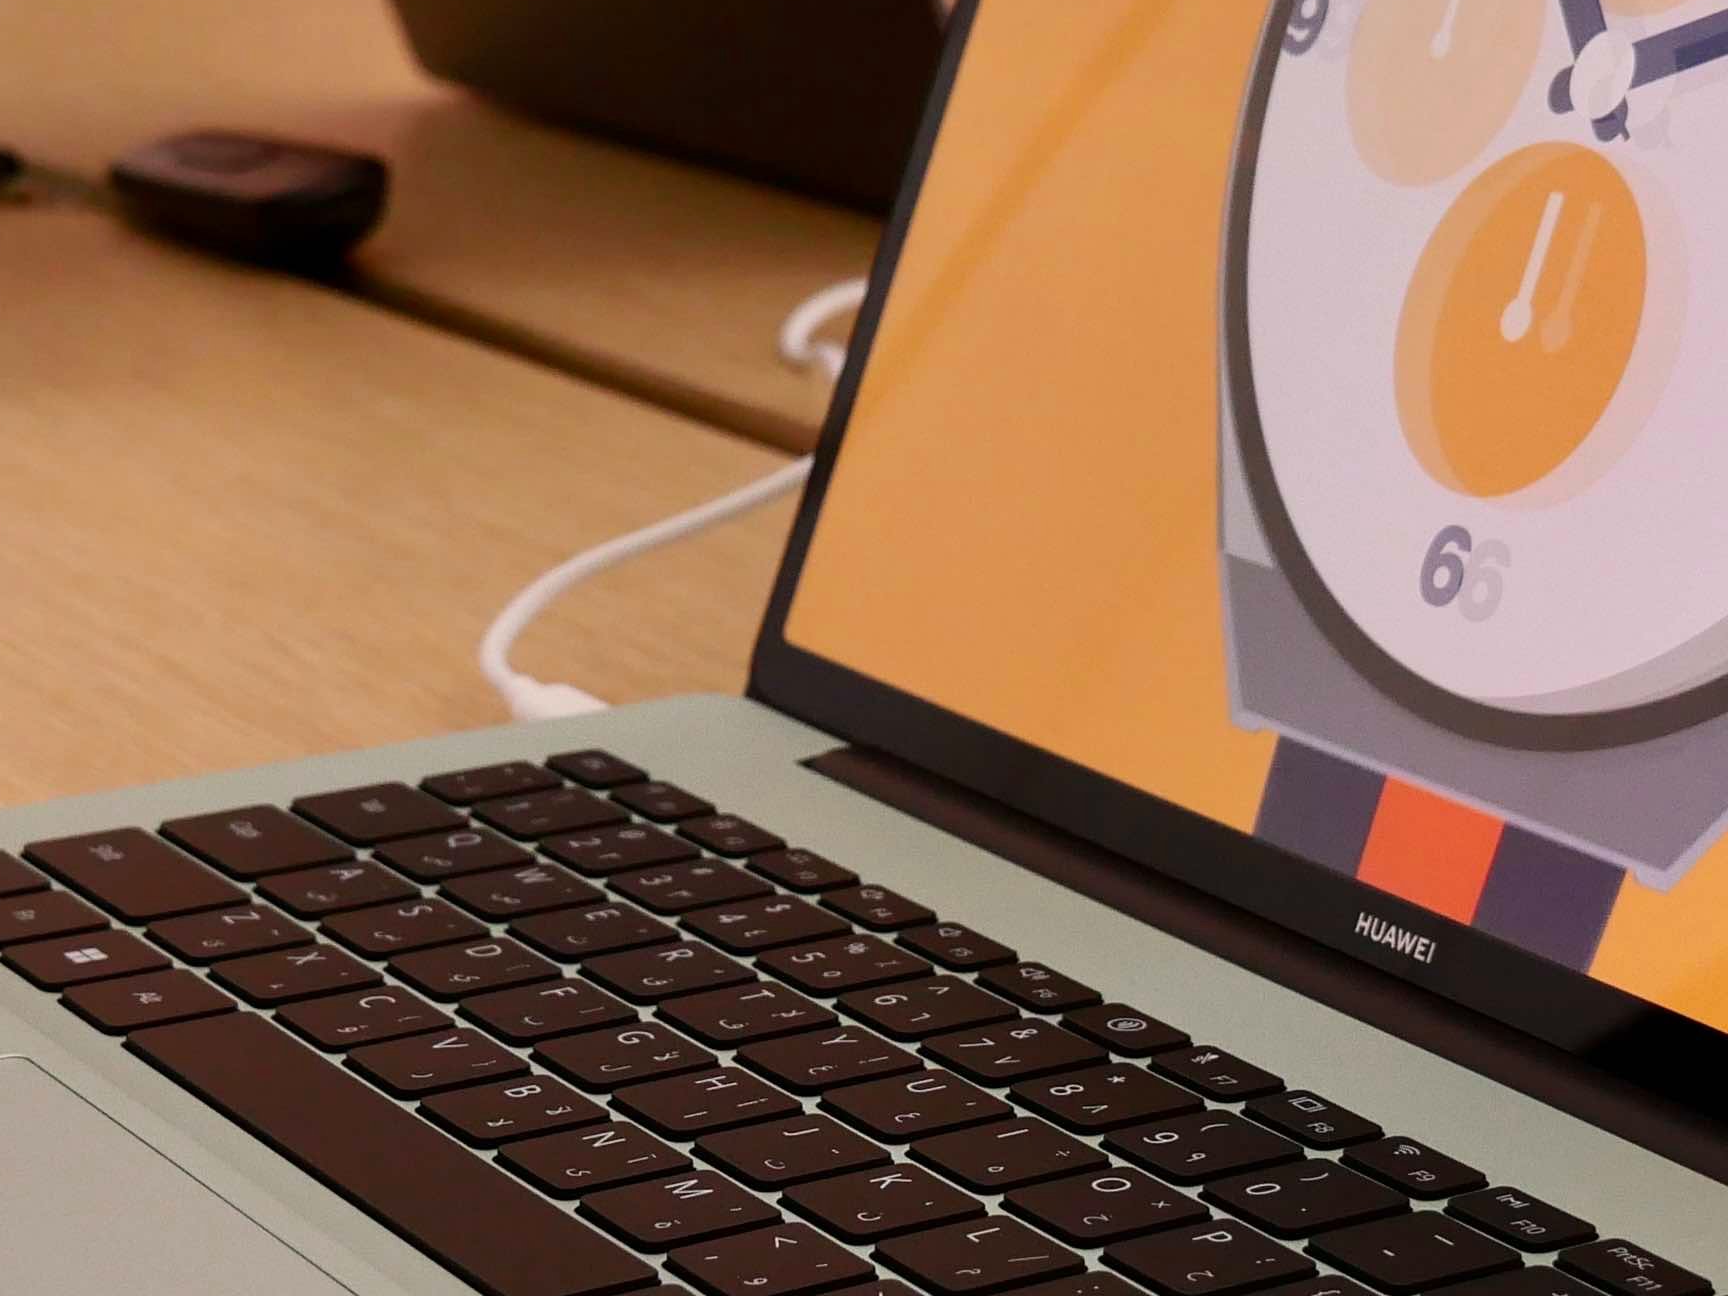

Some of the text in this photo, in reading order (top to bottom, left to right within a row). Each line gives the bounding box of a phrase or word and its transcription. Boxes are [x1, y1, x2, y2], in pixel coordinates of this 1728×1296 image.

[1419, 525, 1473, 607] 6
[331, 868, 364, 880] A
[514, 867, 553, 884] W
[397, 905, 433, 917] S
[585, 909, 620, 921] E
[222, 911, 261, 925] Z
[1354, 912, 1437, 964] HUAWEI
[465, 944, 502, 957] D
[659, 948, 694, 962] R
[791, 951, 826, 963] 5
[287, 951, 326, 966] X
[540, 986, 578, 997] F
[740, 989, 776, 1000] T
[359, 995, 396, 1009] C
[874, 994, 908, 1006] 6
[432, 1036, 469, 1049] V
[617, 1030, 655, 1045] G
[821, 1033, 858, 1045] Y
[959, 1037, 996, 1048] 7
[695, 1075, 738, 1091] H
[906, 1078, 947, 1093] U
[1209, 1074, 1238, 1085] F7
[503, 1084, 542, 1098] B
[1049, 1084, 1085, 1096] 8
[783, 1127, 820, 1137] J
[996, 1128, 1029, 1139] I
[1307, 1122, 1335, 1134] F8
[582, 1130, 626, 1148] N
[1143, 1132, 1179, 1144] 9
[869, 1173, 913, 1189] K
[1407, 1169, 1436, 1182] F9
[664, 1179, 714, 1199] M
[1091, 1177, 1132, 1193] O
[1245, 1183, 1281, 1196] 0
[1510, 1219, 1547, 1235] F10
[966, 1227, 1001, 1243] L
[1191, 1230, 1233, 1243] P
[1607, 1247, 1655, 1271] PrtSc
[1626, 1275, 1663, 1291] F11
